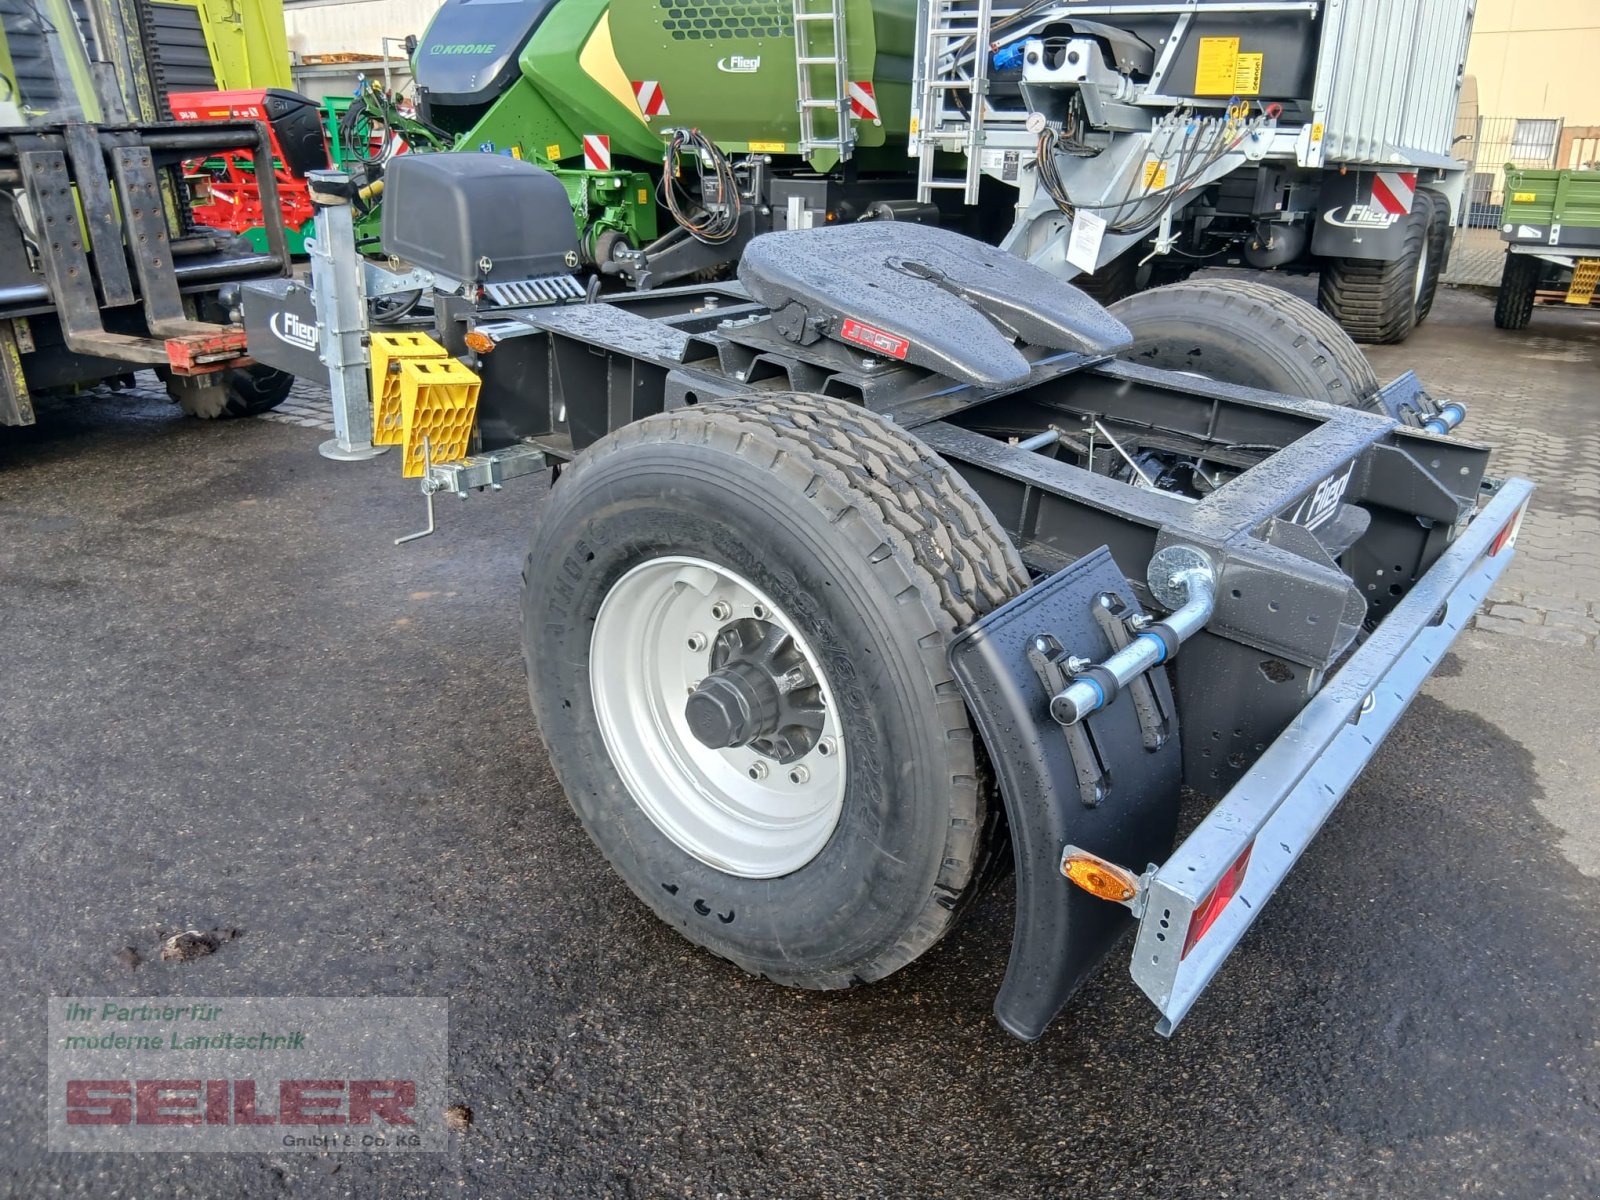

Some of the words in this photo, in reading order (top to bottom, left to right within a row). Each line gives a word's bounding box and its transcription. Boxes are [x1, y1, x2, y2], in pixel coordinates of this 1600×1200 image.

[442, 44, 496, 54] KRONE
[730, 56, 760, 70] Fliegl
[1304, 459, 1355, 526] Fliegl
